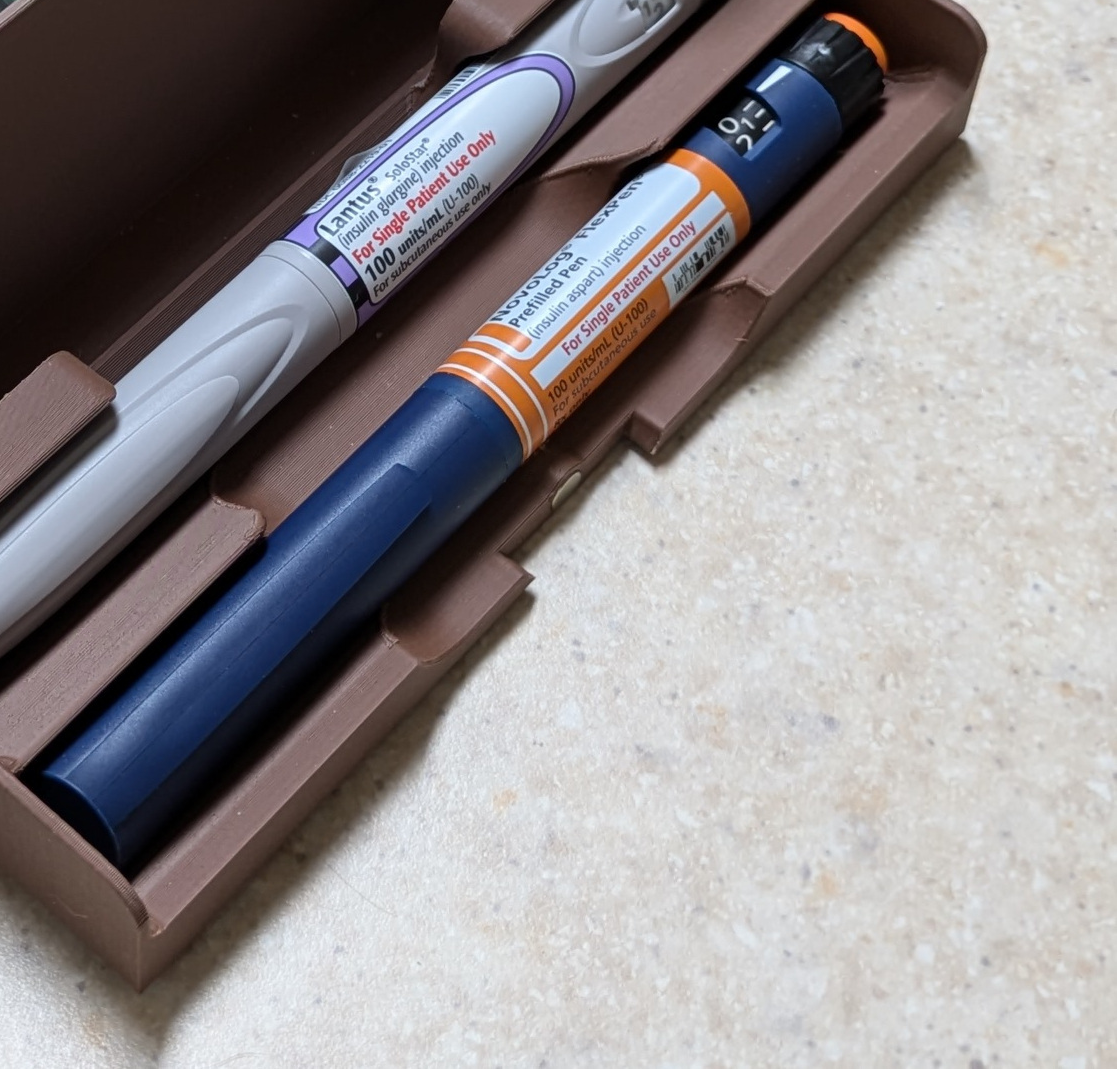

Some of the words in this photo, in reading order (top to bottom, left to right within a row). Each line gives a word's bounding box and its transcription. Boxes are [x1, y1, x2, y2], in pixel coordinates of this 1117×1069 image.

[718, 117, 739, 134] 0
[741, 117, 756, 131] 1
[337, 210, 379, 250] (insulin
[377, 168, 423, 217] glargine)
[417, 131, 464, 174] injection
[352, 241, 375, 265] For
[372, 210, 410, 246] Single
[406, 171, 450, 214] Patient
[445, 154, 471, 177] Use
[467, 130, 497, 158] Only
[365, 247, 396, 281] 100
[398, 208, 445, 255] units/mL
[442, 173, 479, 215] (U-100)
[373, 277, 389, 297] For
[390, 218, 454, 282] subcutaneous
[454, 202, 471, 222] use
[471, 182, 491, 206] only
[508, 278, 564, 329] Prefilled
[559, 255, 588, 279] Pen
[527, 301, 569, 340] (insulin
[566, 265, 605, 303] aspart)
[598, 225, 647, 269] injection
[562, 333, 583, 356] For
[580, 302, 615, 338] Single
[612, 264, 653, 305] Patient
[648, 246, 672, 268] Use
[669, 221, 697, 248] Only
[548, 379, 568, 403] 100
[568, 337, 612, 384] units/mL
[611, 298, 649, 341] (U-100)
[553, 395, 570, 417] For
[571, 328, 638, 399] subcutaneous
[639, 309, 657, 329] use
